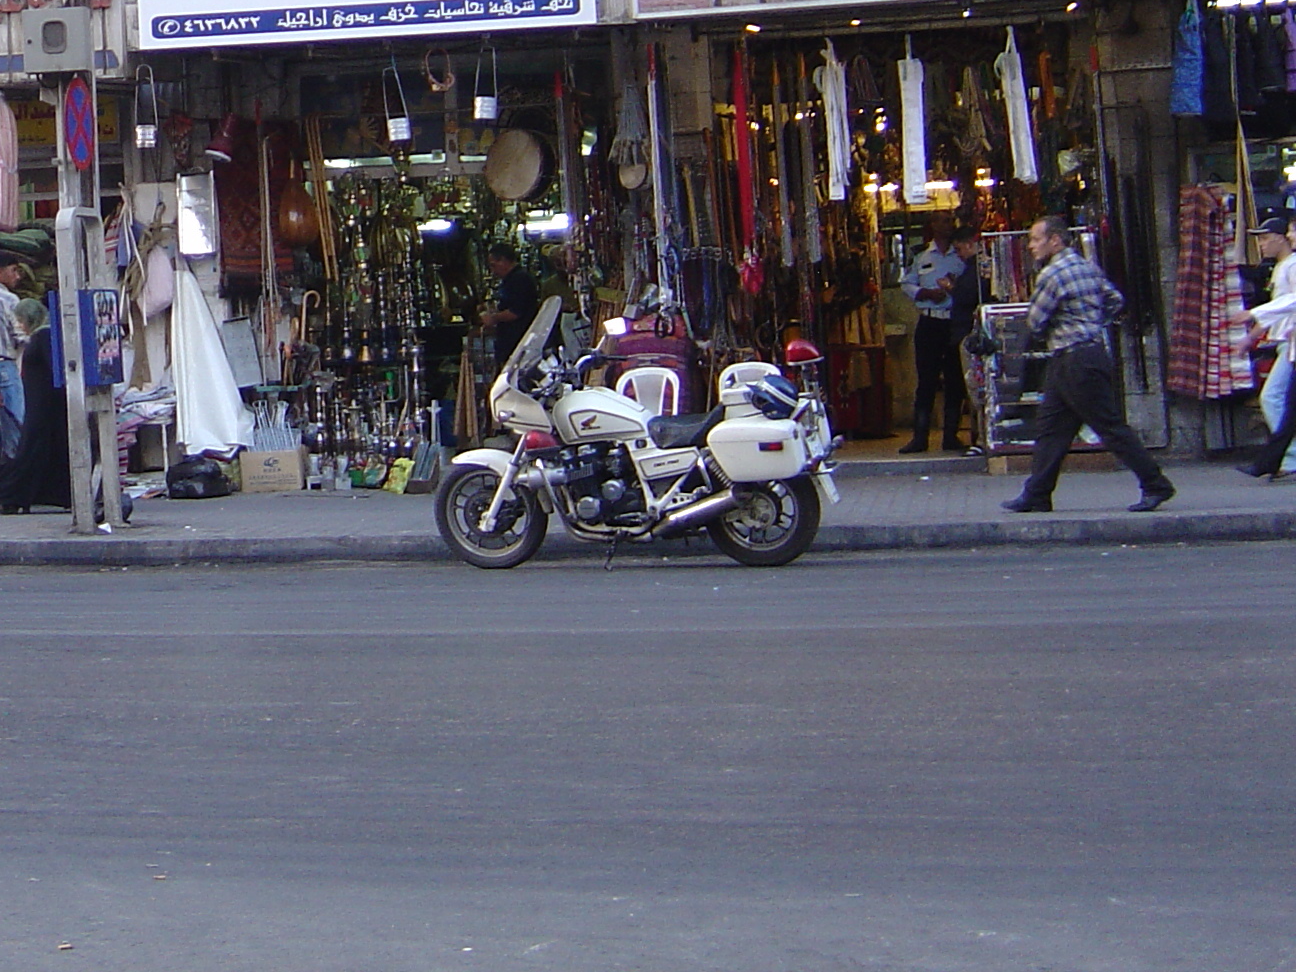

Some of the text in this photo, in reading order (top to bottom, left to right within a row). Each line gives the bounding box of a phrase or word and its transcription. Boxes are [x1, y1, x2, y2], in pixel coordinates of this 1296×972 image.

[379, 3, 419, 22] خزف
[424, 0, 485, 20] نحاسيات
[488, 0, 536, 16] شرقية
